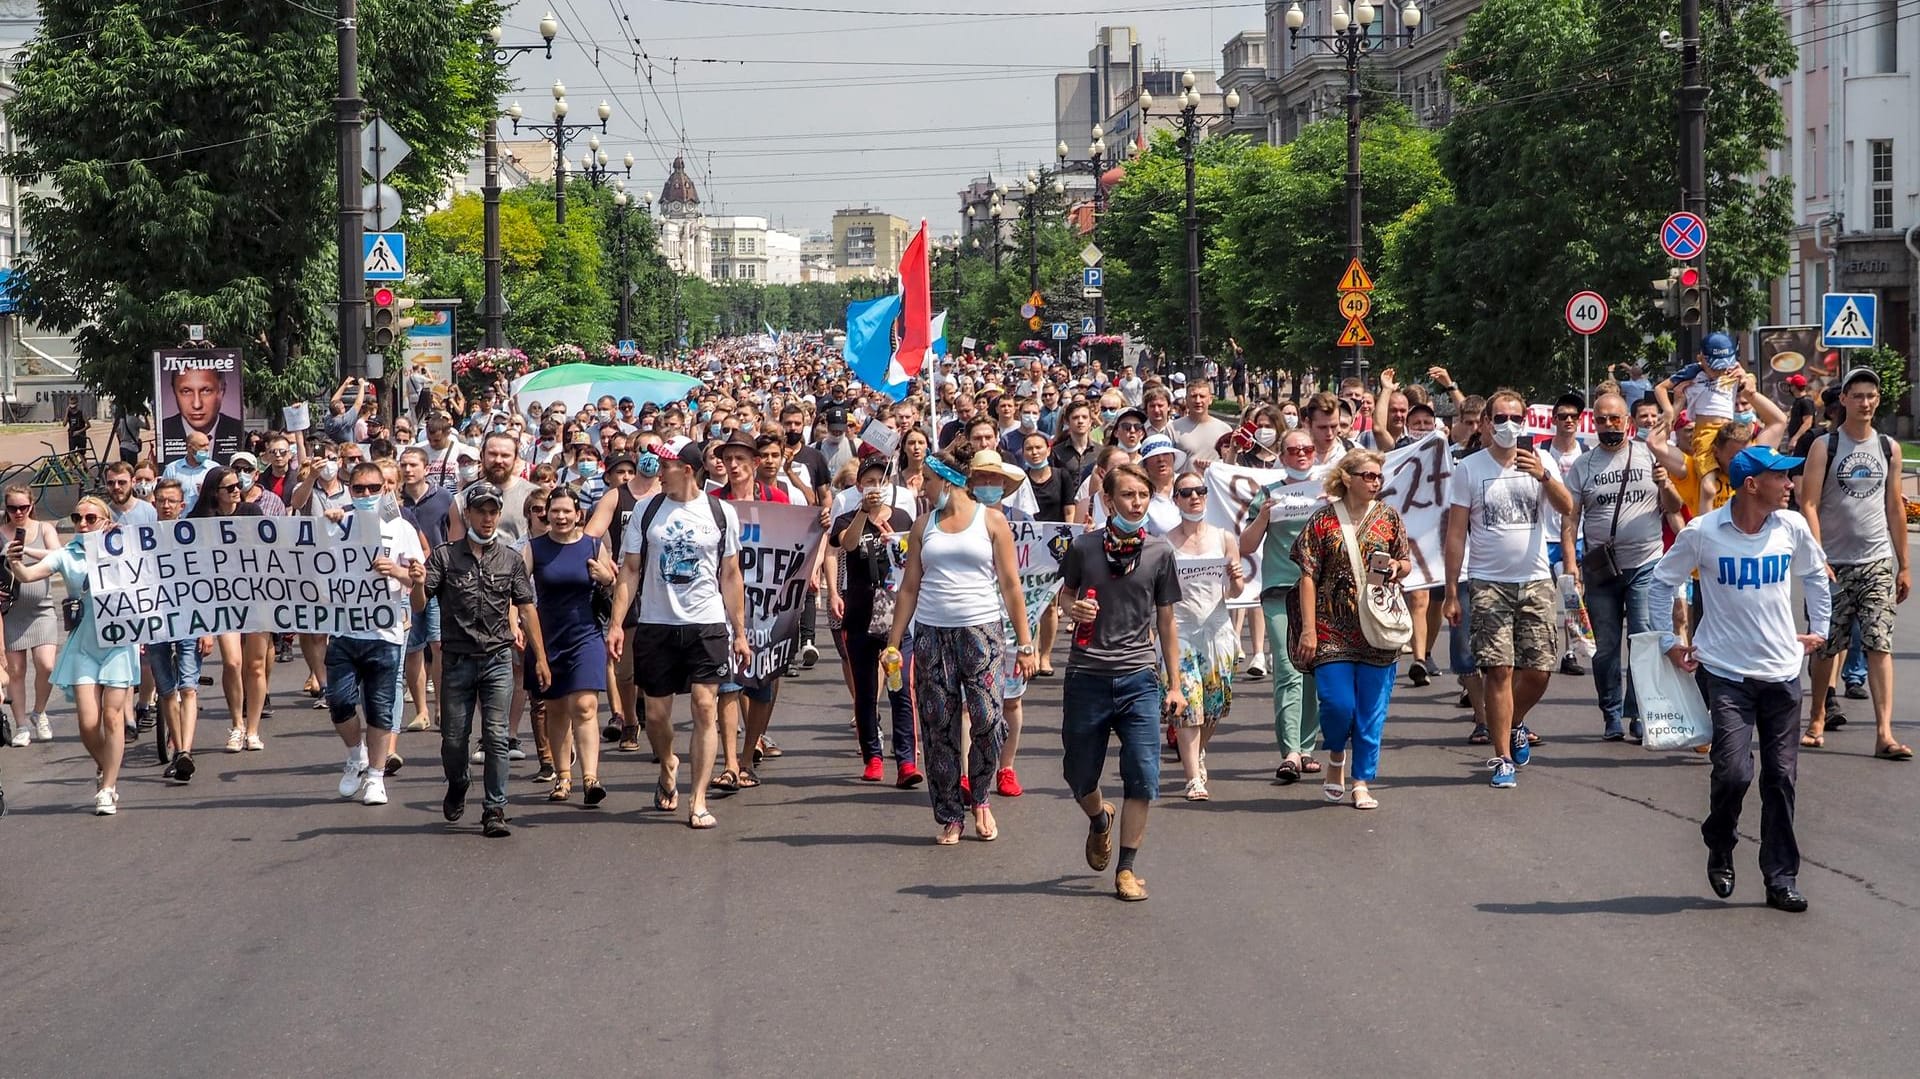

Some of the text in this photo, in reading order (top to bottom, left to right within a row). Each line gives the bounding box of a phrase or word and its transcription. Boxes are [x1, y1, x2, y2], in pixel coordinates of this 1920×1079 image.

[1088, 270, 1099, 285] P
[1847, 260, 1888, 272] ЕТАЛЛ
[1346, 299, 1363, 311] 40
[1575, 304, 1598, 320] 40
[1594, 468, 1643, 486] СВОБДУ
[1597, 490, 1646, 505] ФУАЛУ
[104, 514, 354, 556] СВОБОДУ
[97, 546, 380, 590] ГУБЕРНАТОРУ
[739, 543, 806, 586] РГЕЙ
[1717, 554, 1791, 590] ЛДПР
[94, 577, 391, 619] ХАБАРОВСКОГО КРАЯ
[745, 579, 806, 622] РГАЛ
[101, 604, 395, 645] ФУРГАЛУ СЕРГЕЮ
